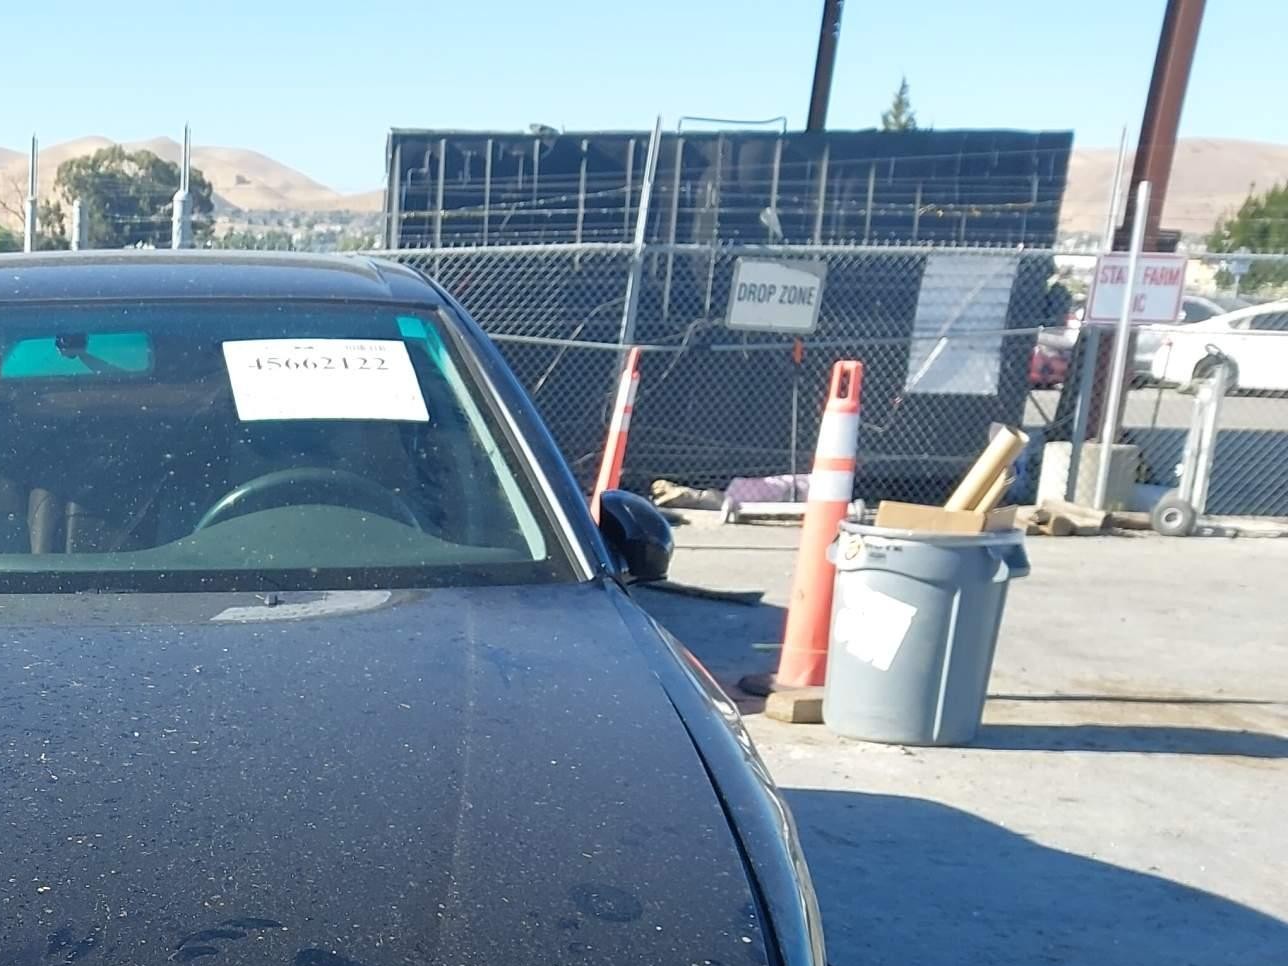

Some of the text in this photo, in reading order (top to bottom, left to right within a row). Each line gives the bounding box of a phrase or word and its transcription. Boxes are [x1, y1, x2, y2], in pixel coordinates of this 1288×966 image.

[737, 282, 816, 306] DROP ZONE
[248, 356, 389, 371] 45662122
